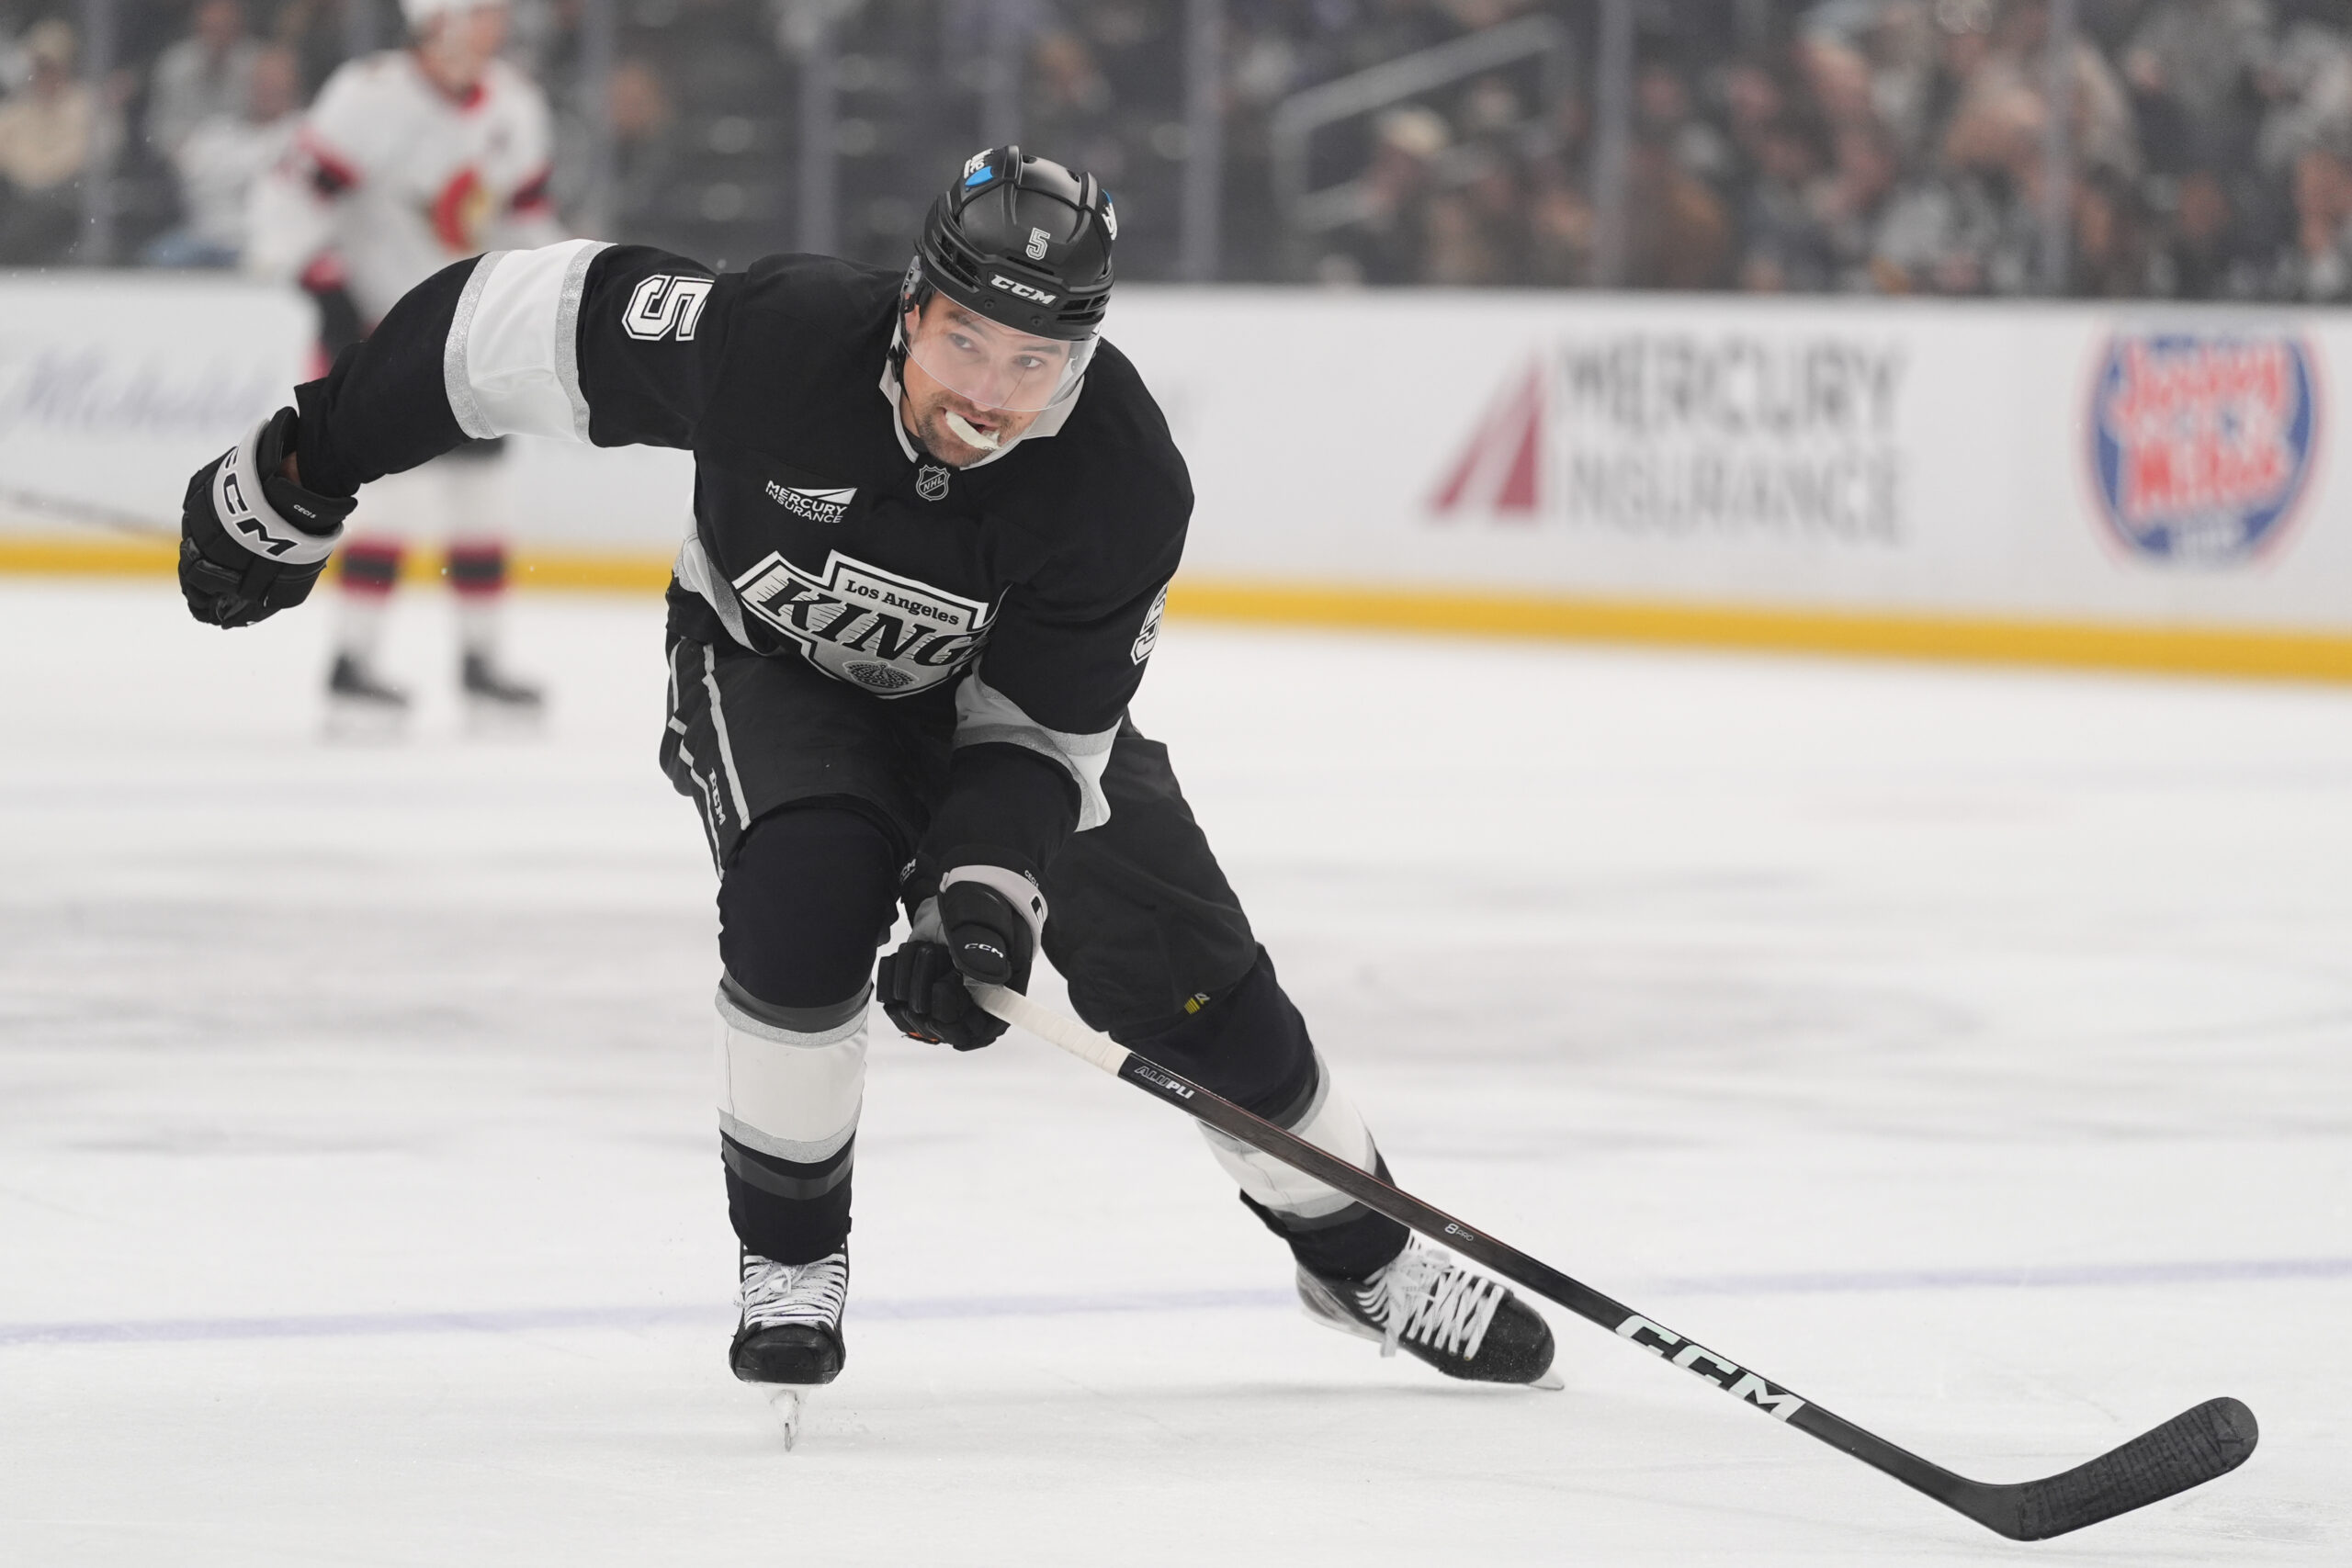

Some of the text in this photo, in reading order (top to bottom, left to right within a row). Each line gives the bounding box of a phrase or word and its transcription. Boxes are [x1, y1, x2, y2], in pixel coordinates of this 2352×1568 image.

[1026, 227, 1050, 260] 5
[622, 275, 715, 341] 5
[990, 275, 1057, 305] CCM
[766, 479, 847, 515] MERCURY
[922, 475, 944, 492] NHL
[765, 486, 843, 524] INSURANCE
[844, 580, 959, 626] Los Angeles
[756, 577, 977, 666] KING
[965, 943, 1004, 958] CCM
[1444, 1223, 1474, 1241] 8 PRO
[1614, 1314, 1807, 1422] CCM
